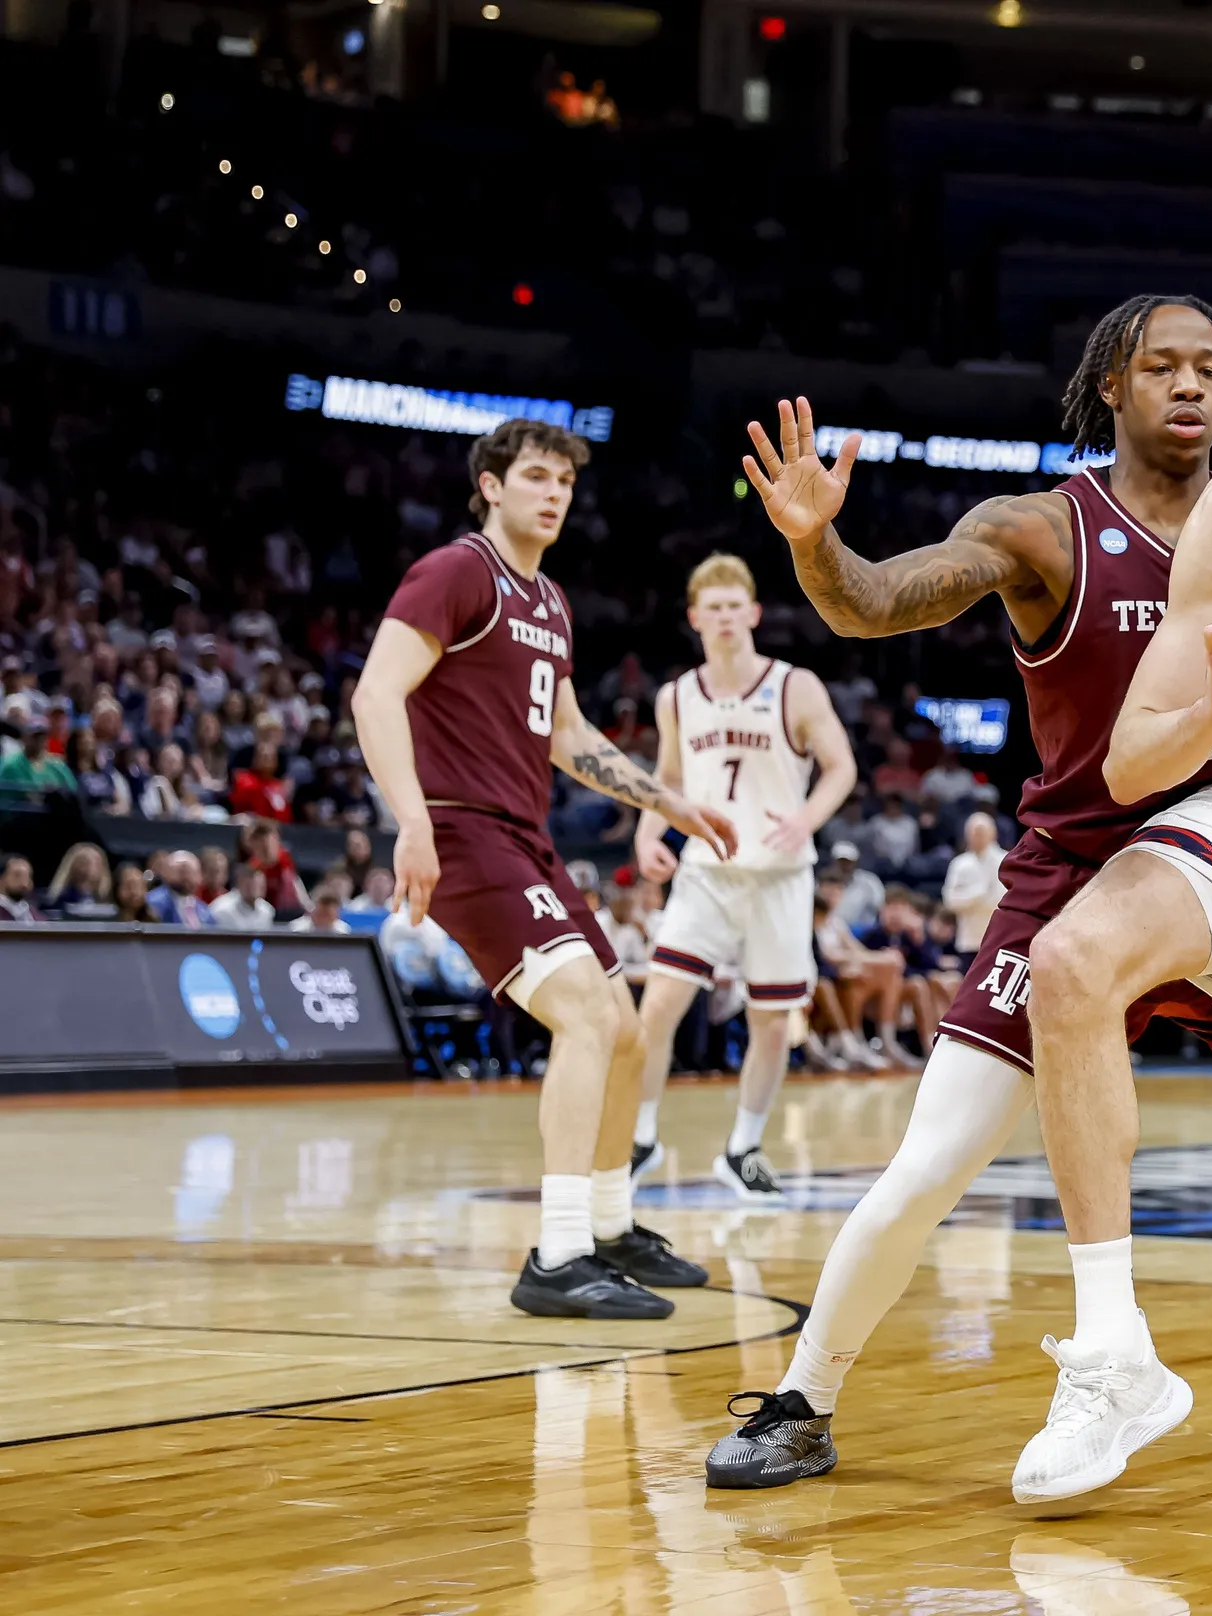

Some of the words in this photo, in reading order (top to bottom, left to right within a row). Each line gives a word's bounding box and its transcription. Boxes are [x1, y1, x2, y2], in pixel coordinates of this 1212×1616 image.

[1103, 538, 1127, 549] NCAA
[527, 658, 555, 738] 9
[721, 757, 743, 802] 7
